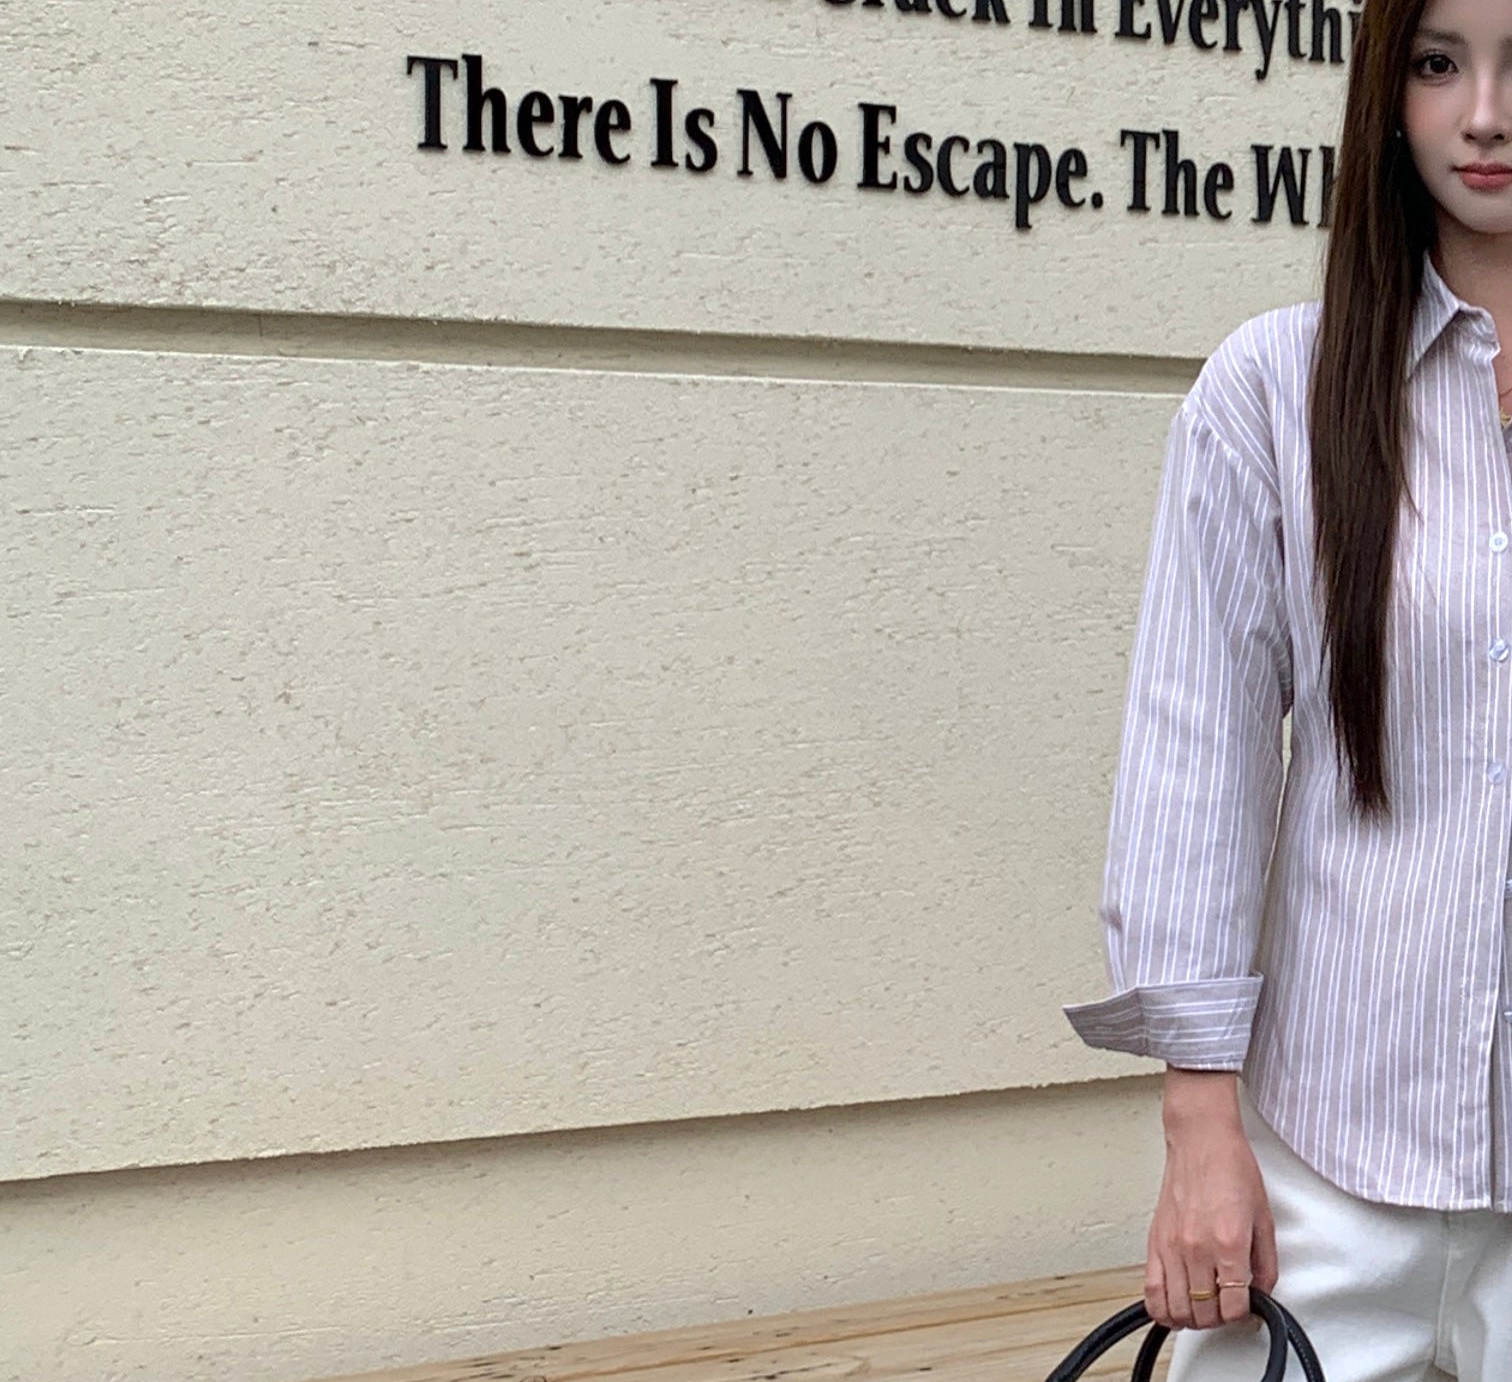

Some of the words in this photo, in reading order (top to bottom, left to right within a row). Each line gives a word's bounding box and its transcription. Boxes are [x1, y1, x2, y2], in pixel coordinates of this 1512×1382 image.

[406, 54, 632, 168] There
[649, 77, 718, 176] Is
[736, 88, 838, 187] No
[856, 102, 1104, 233] Escape.
[1119, 129, 1235, 222] The
